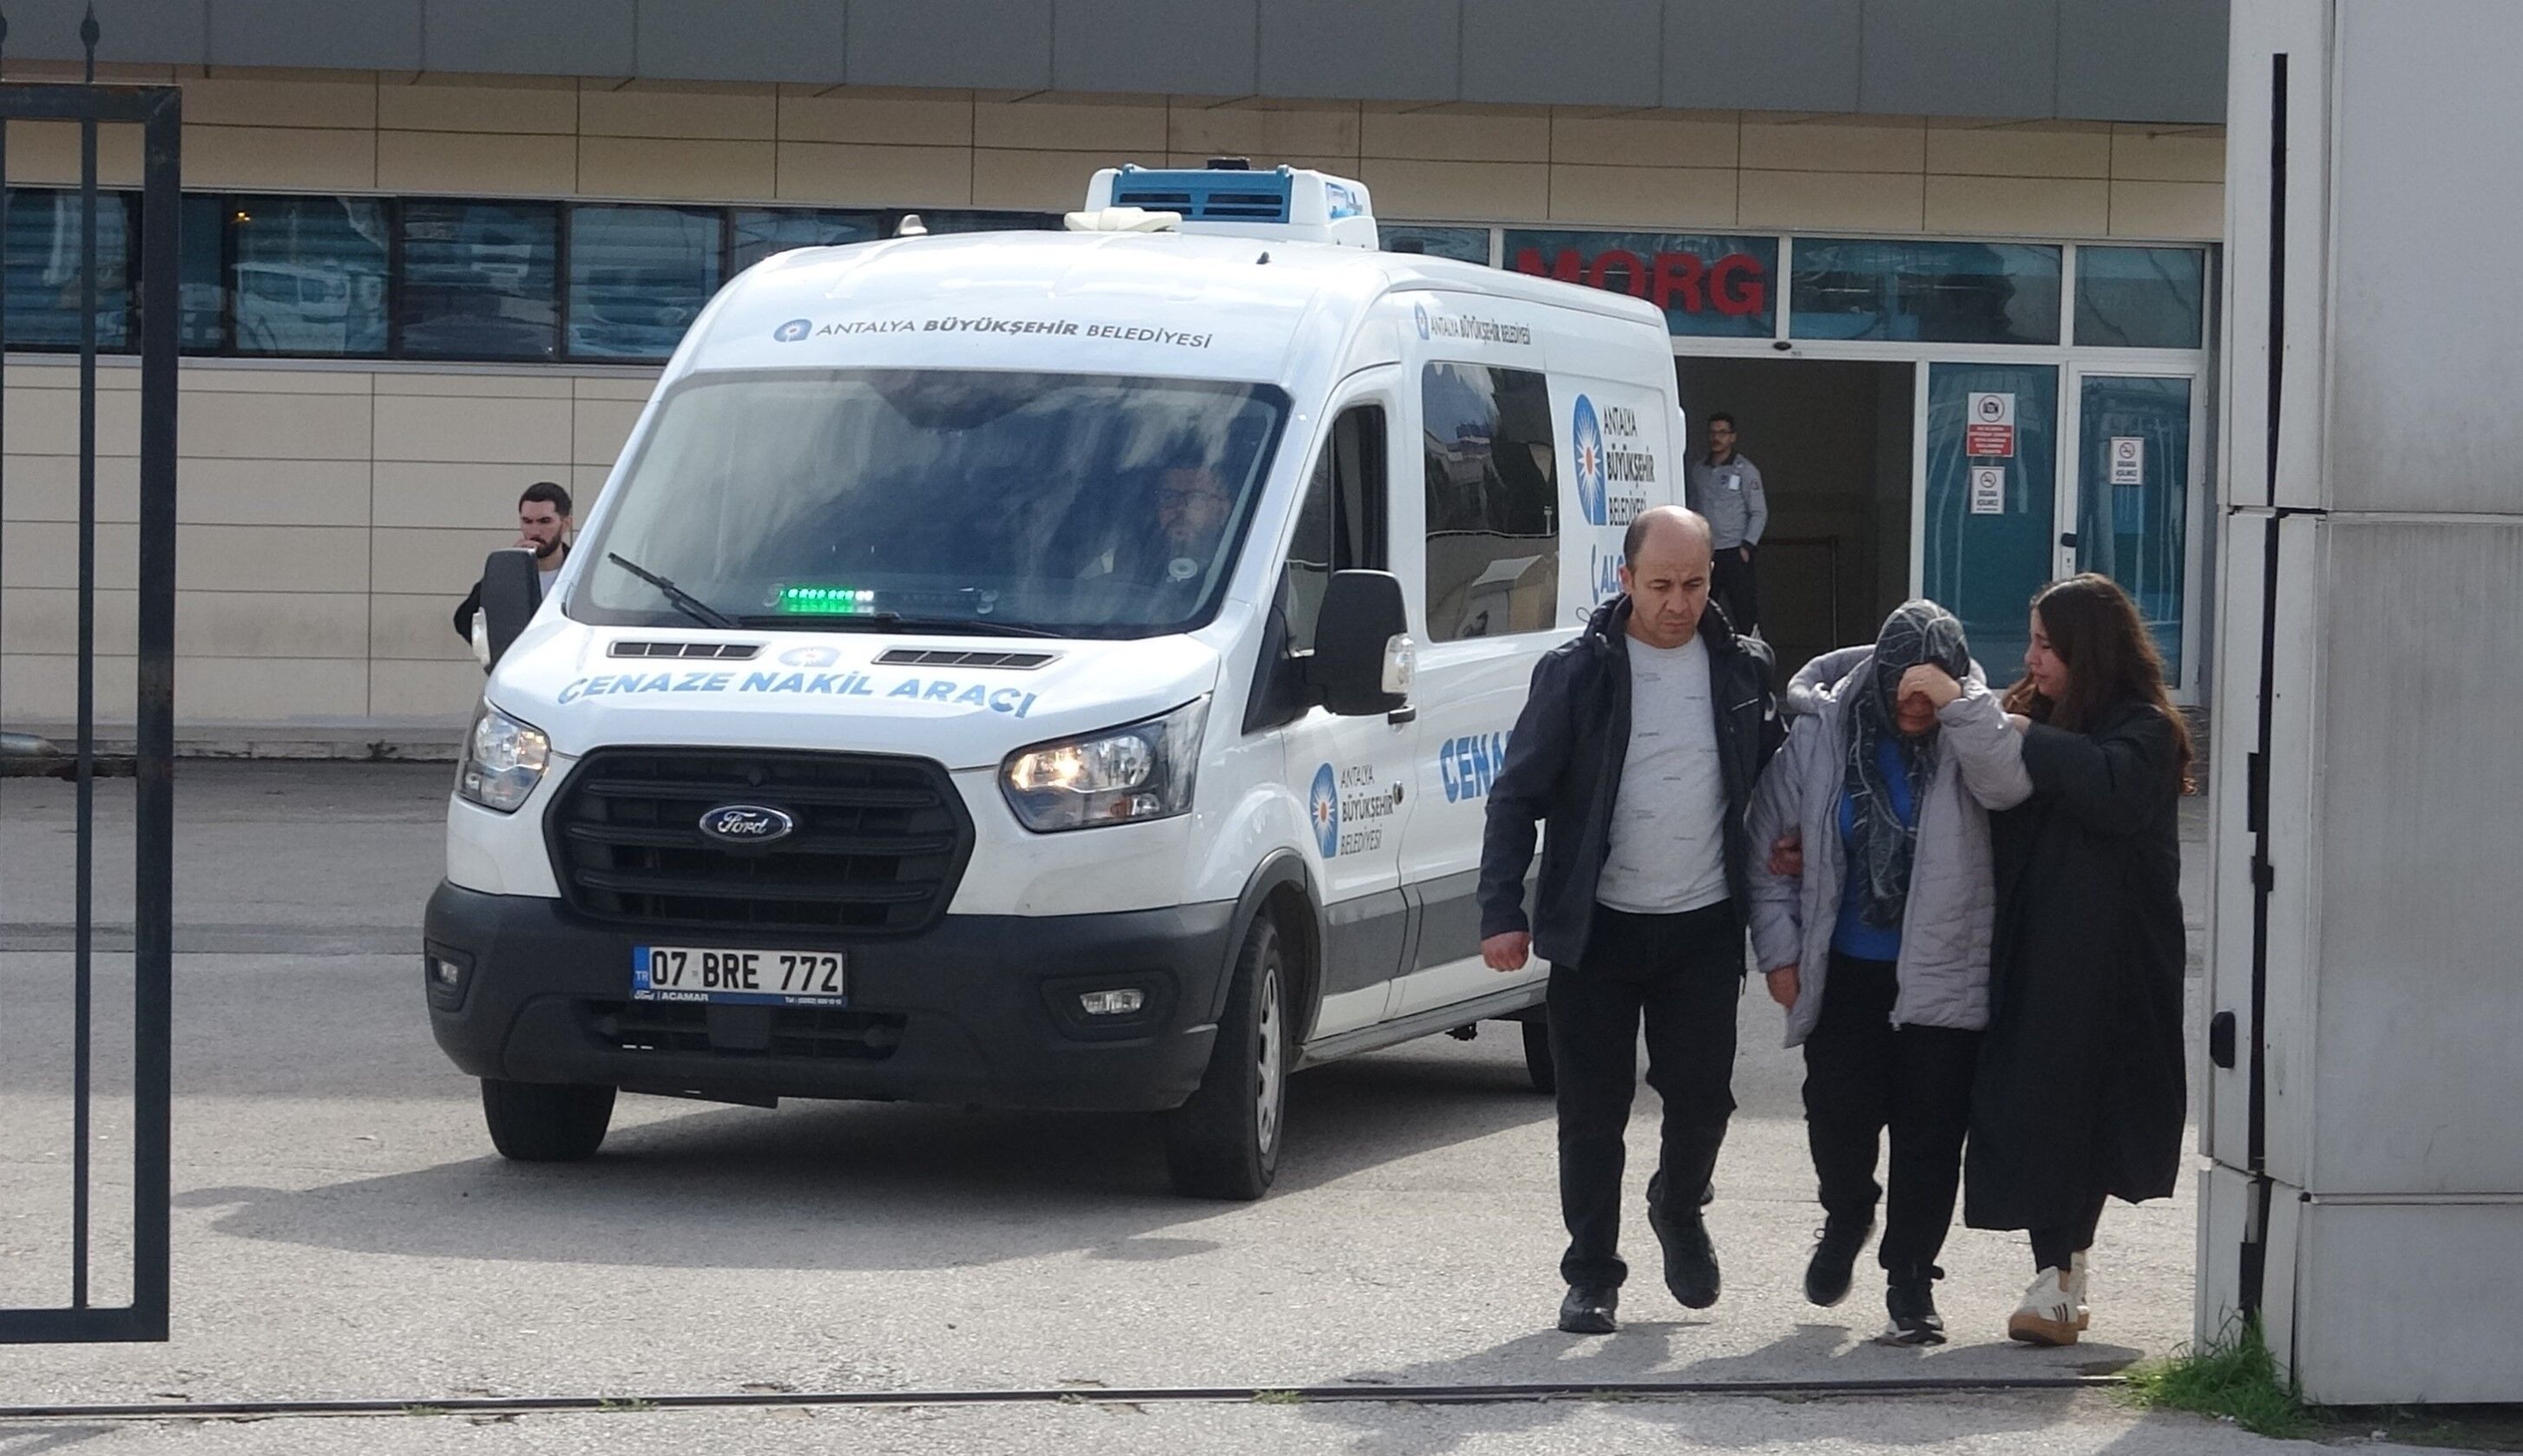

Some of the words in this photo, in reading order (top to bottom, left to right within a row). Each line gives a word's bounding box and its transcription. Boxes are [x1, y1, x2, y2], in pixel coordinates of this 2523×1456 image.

[816, 319, 915, 336] ANTALYA
[923, 317, 1080, 338] BÜYÜKŞEHİR
[1086, 325, 1213, 349] BELEDİYESİ
[1604, 407, 1638, 437] ANTALYA
[1606, 443, 1655, 489] BÜYÜKŞEHİR
[557, 672, 735, 705] CENAZE
[739, 670, 874, 695] NAKİL
[886, 679, 1038, 718] ARACI
[1340, 764, 1375, 789] ANTALYA
[1441, 731, 1514, 803] CENA
[718, 810, 769, 833] Ford
[1342, 789, 1394, 824] BÜYÜKŞEHİR
[1340, 824, 1383, 856] BELEDİYESİ
[635, 970, 648, 981] TR
[652, 951, 687, 987] 07
[702, 952, 759, 990] BRE
[780, 955, 838, 993] 772
[661, 992, 709, 1001] ACAMAR
